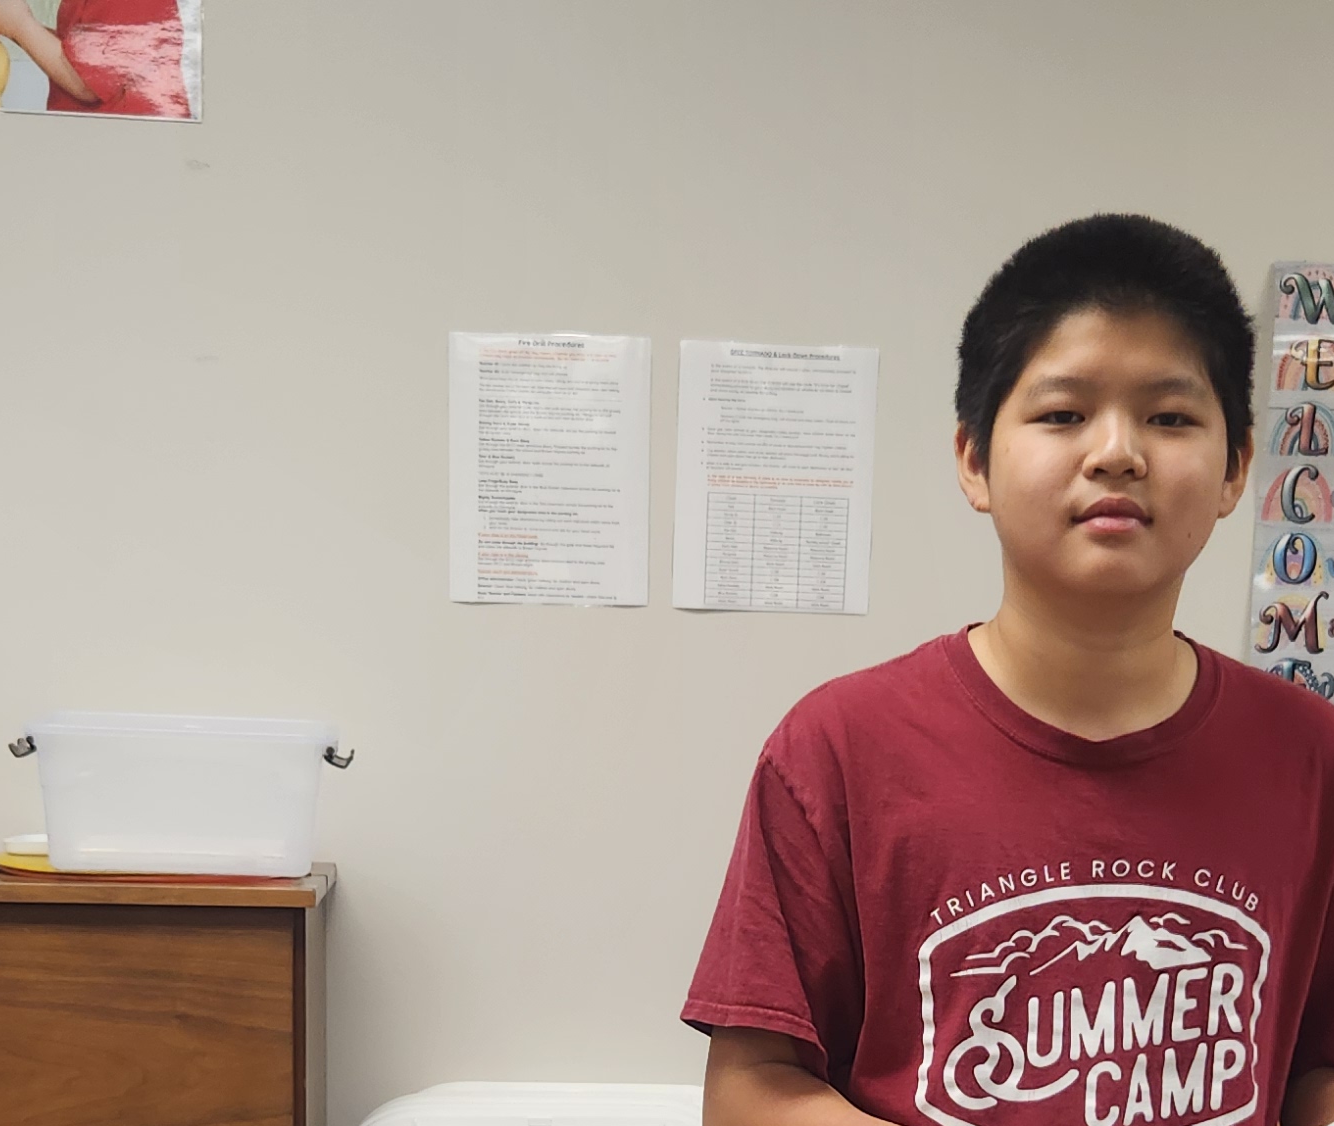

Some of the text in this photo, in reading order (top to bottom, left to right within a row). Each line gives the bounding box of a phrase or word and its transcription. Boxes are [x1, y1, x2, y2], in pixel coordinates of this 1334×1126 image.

[547, 341, 585, 349] Procedures
[930, 860, 1260, 926] TRIANGLE ROCK CLUB
[943, 962, 1244, 1111] SUMMER
